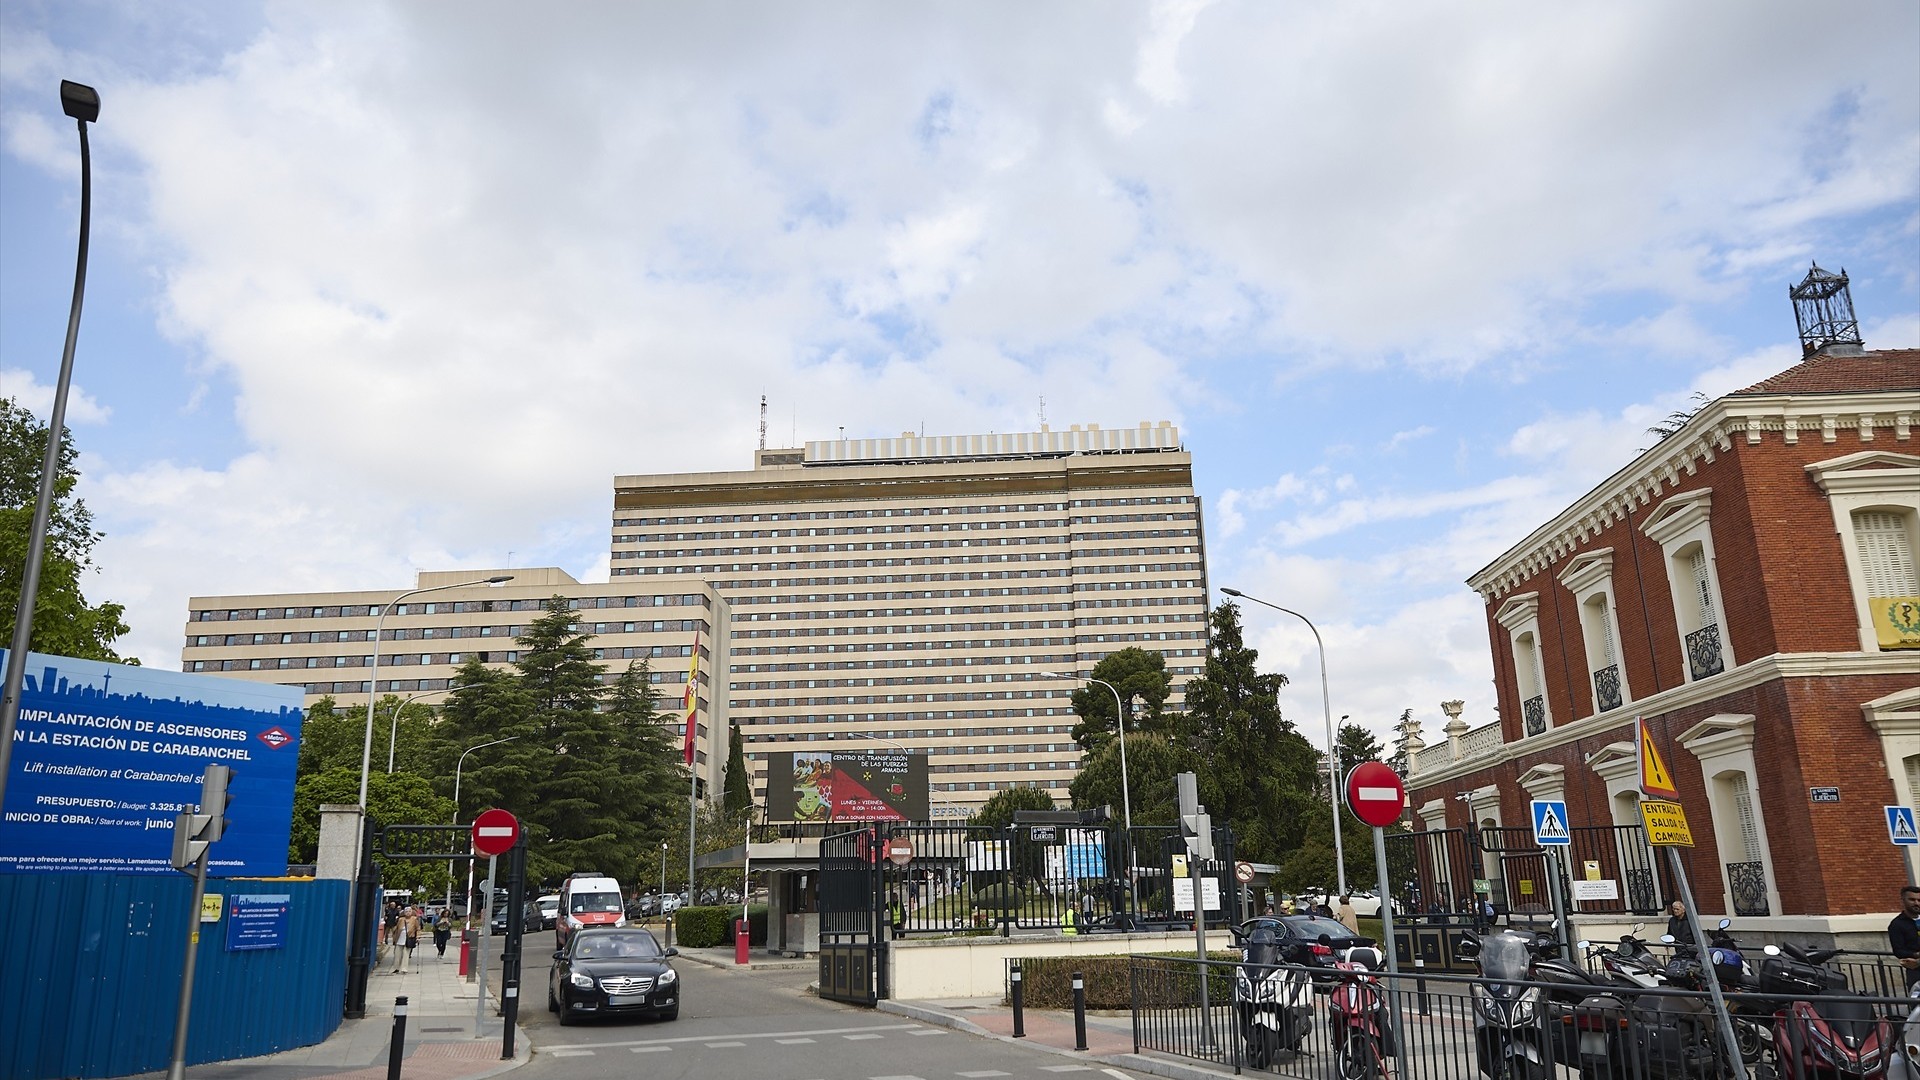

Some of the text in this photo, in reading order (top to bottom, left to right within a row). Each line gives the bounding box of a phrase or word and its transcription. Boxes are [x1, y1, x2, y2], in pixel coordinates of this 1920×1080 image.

[20, 708, 246, 741] IMPLANTACIÓN DE ASCENSORES
[29, 732, 48, 744] LA
[52, 734, 126, 750] ESTACIÓN
[130, 740, 150, 752] DE
[153, 742, 251, 760] CARABANCHEL
[24, 762, 44, 772] Lift
[46, 764, 108, 778] installation
[110, 770, 122, 778] at
[124, 769, 194, 783] Carabanchel
[1646, 804, 1682, 816] ENTRADA Y
[6, 812, 40, 822] INICIO
[44, 814, 58, 822] DE
[144, 818, 174, 830] junio
[1652, 818, 1686, 829] SALIDA DE
[1656, 832, 1690, 842] CAMIONES
